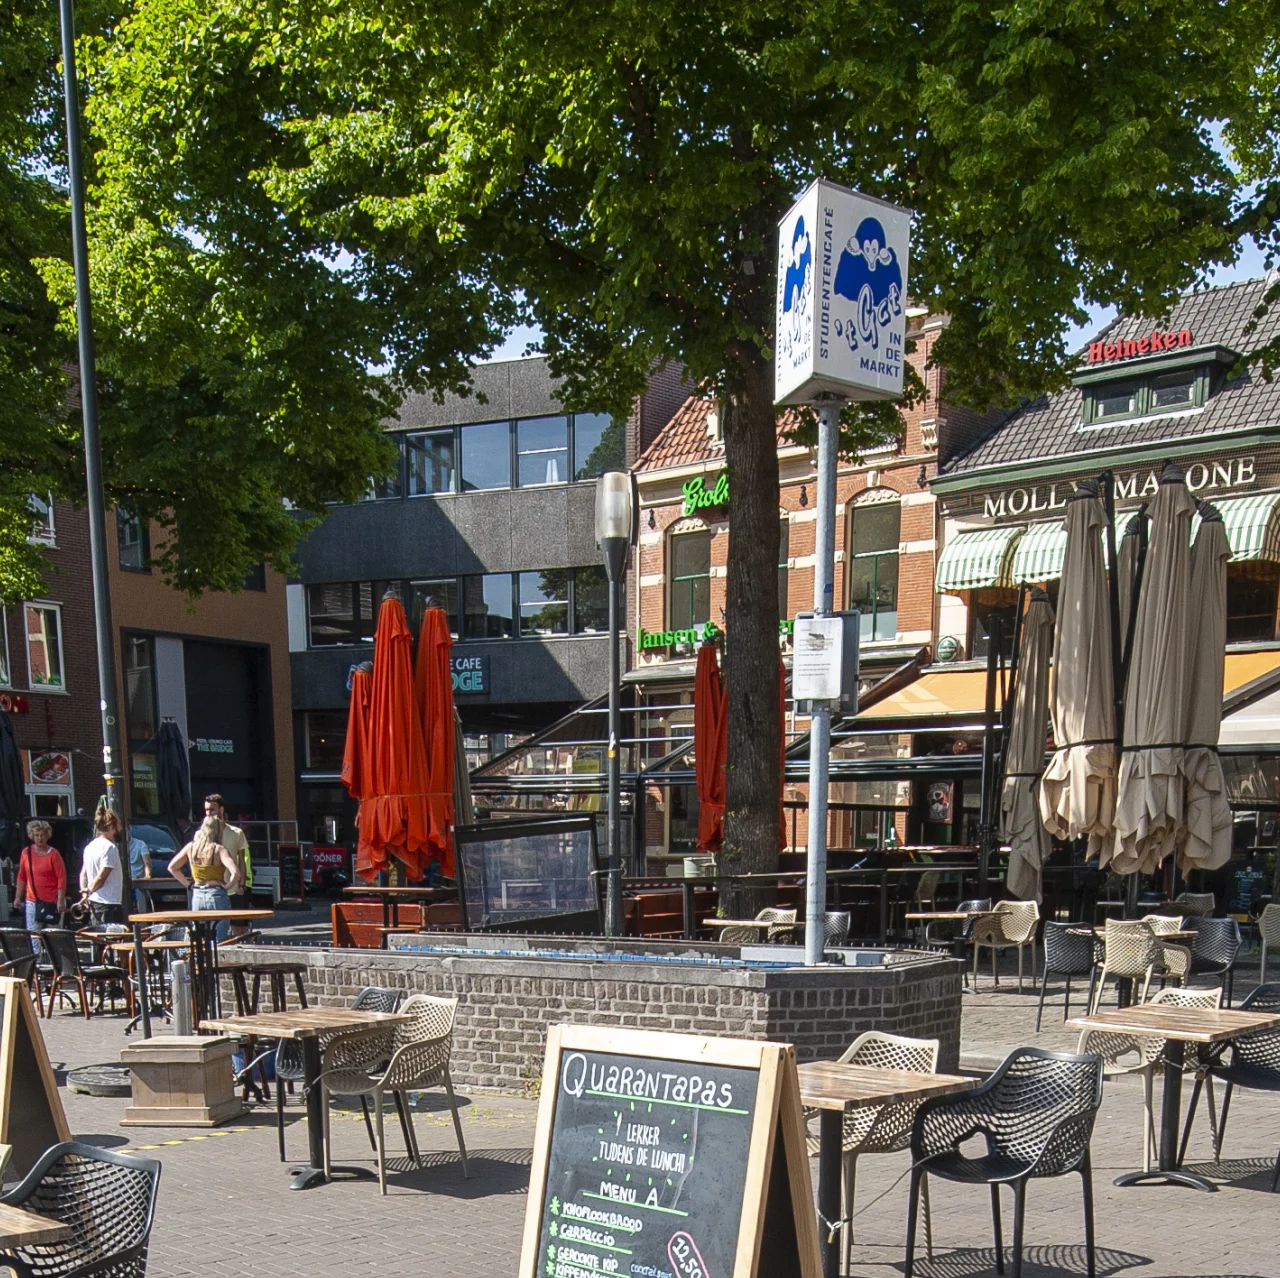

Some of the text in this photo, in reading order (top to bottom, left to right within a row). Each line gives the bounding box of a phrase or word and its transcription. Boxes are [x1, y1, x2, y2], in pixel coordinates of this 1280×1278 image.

[819, 206, 834, 359] STUDENTENCAFÉ
[889, 331, 901, 346] IN
[1087, 328, 1193, 363] Heineken
[859, 356, 900, 377] MARKT
[886, 347, 901, 361] DE
[982, 456, 1257, 518] MOLL MAONE
[637, 626, 696, 652] Jansen
[455, 658, 482, 670] CAFE
[626, 1122, 661, 1147] LEKKER
[635, 1147, 649, 1167] DE
[599, 1181, 660, 1209] MENU A
